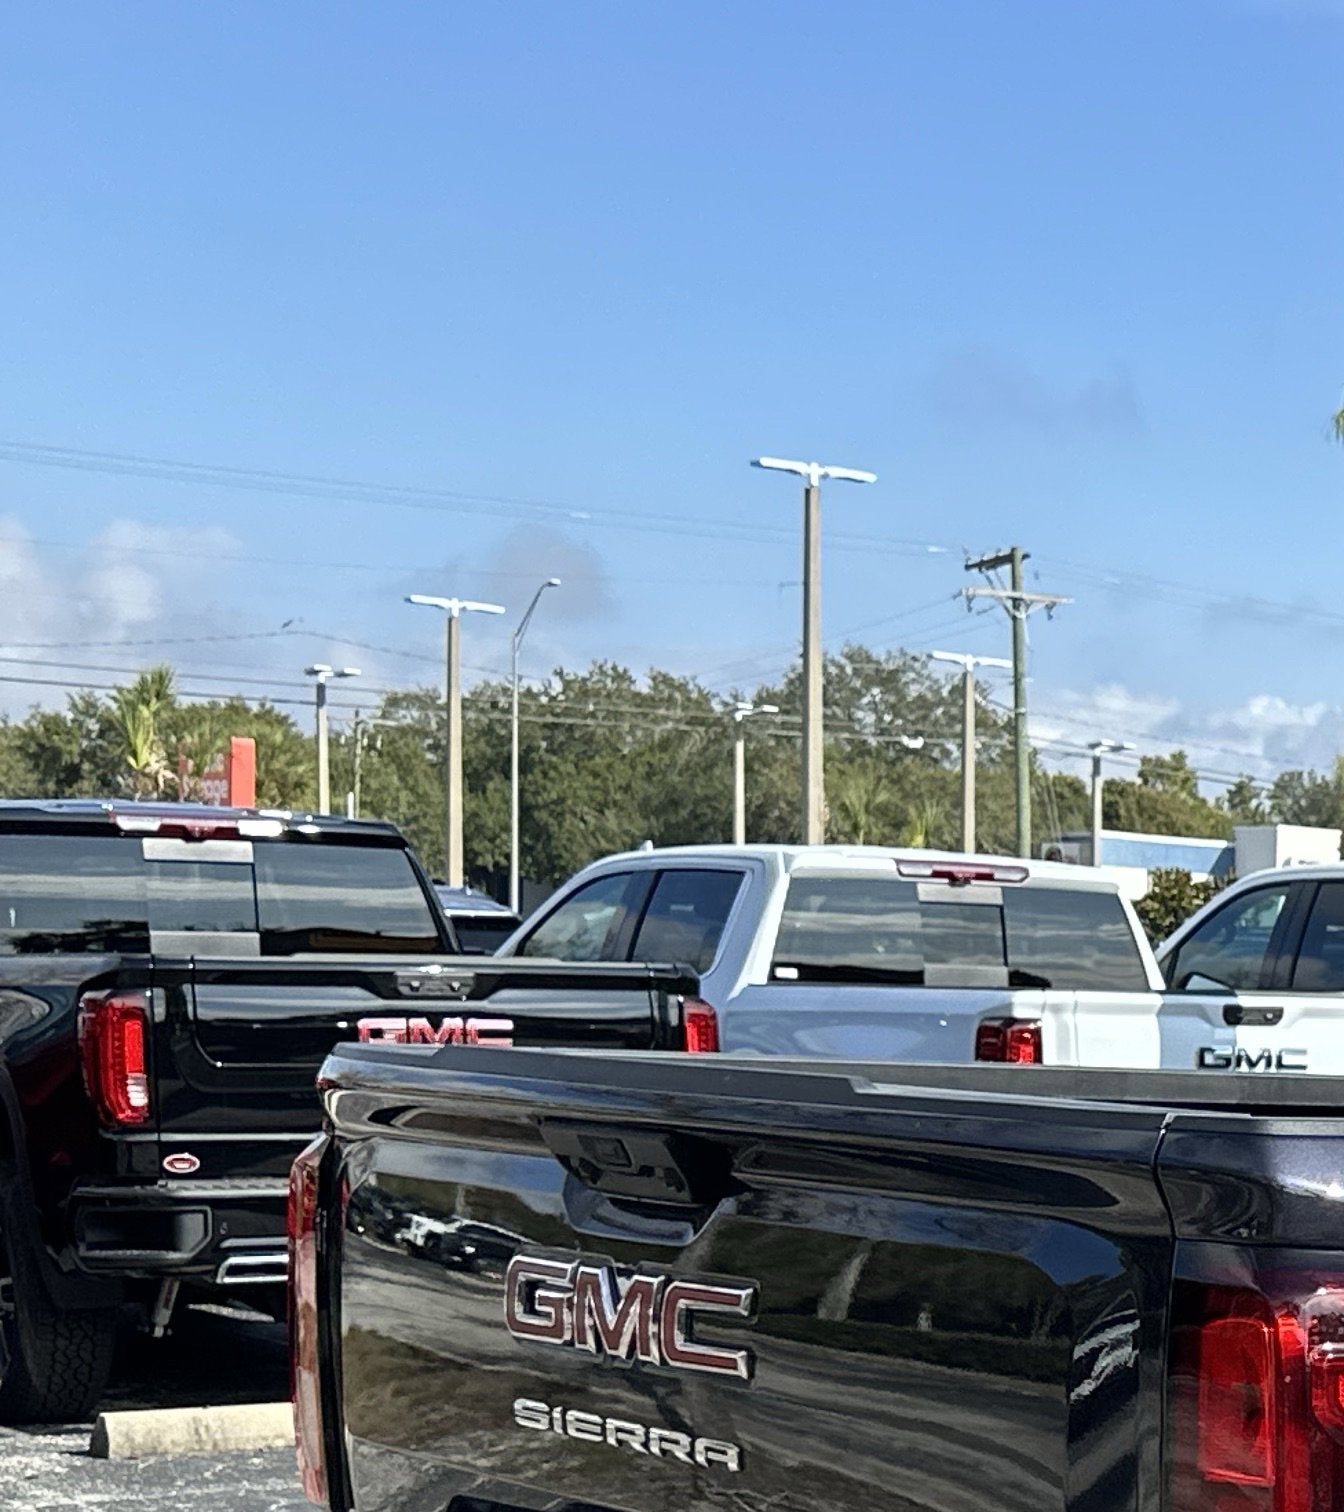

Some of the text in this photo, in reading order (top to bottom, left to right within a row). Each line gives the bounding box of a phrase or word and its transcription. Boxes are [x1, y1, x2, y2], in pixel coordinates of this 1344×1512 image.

[357, 1017, 514, 1047] GMC
[1196, 1046, 1308, 1072] GMC
[504, 1255, 757, 1381] GMC
[513, 1397, 743, 1472] SIERRA
